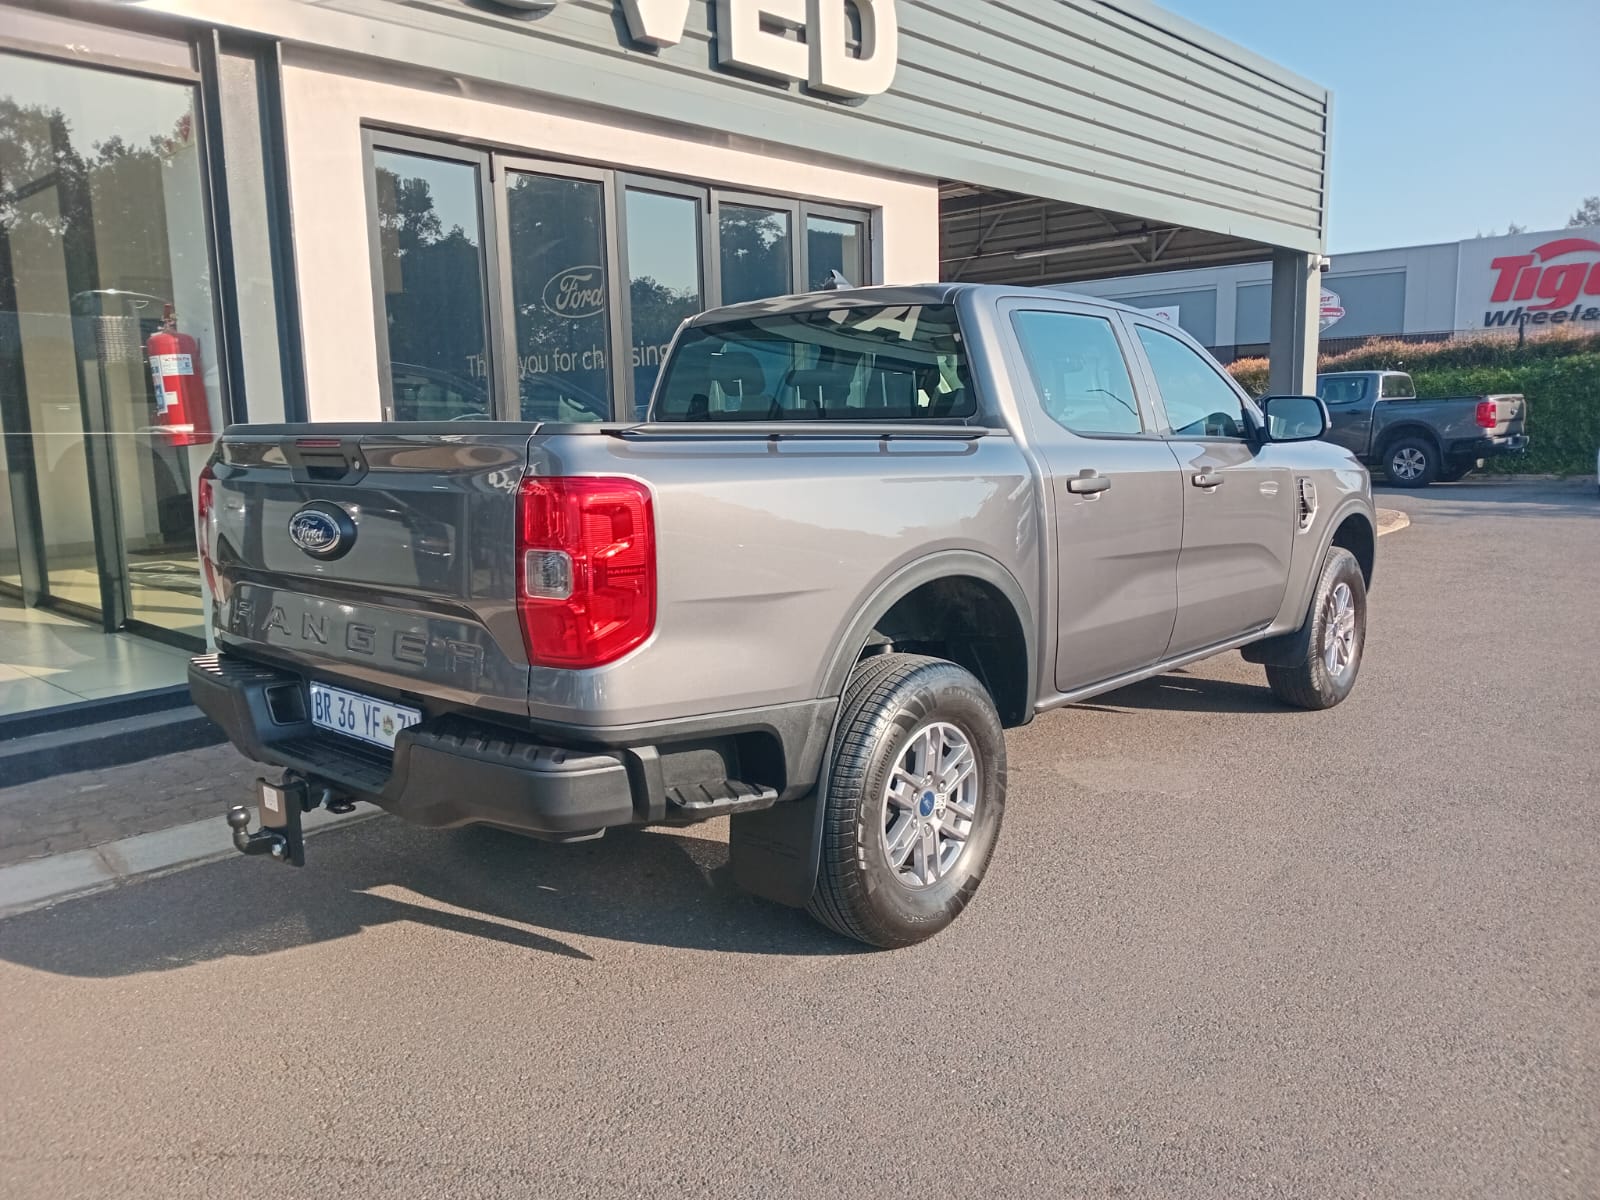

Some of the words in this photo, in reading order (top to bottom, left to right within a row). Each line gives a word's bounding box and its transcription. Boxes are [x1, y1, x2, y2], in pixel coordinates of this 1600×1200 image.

[556, 273, 605, 310] Ford
[518, 354, 549, 380] you
[552, 348, 578, 371] for
[297, 518, 332, 543] Ford
[230, 601, 486, 678] RANGER
[315, 692, 332, 724] BR
[338, 696, 355, 730] 36
[363, 703, 381, 738] YF
